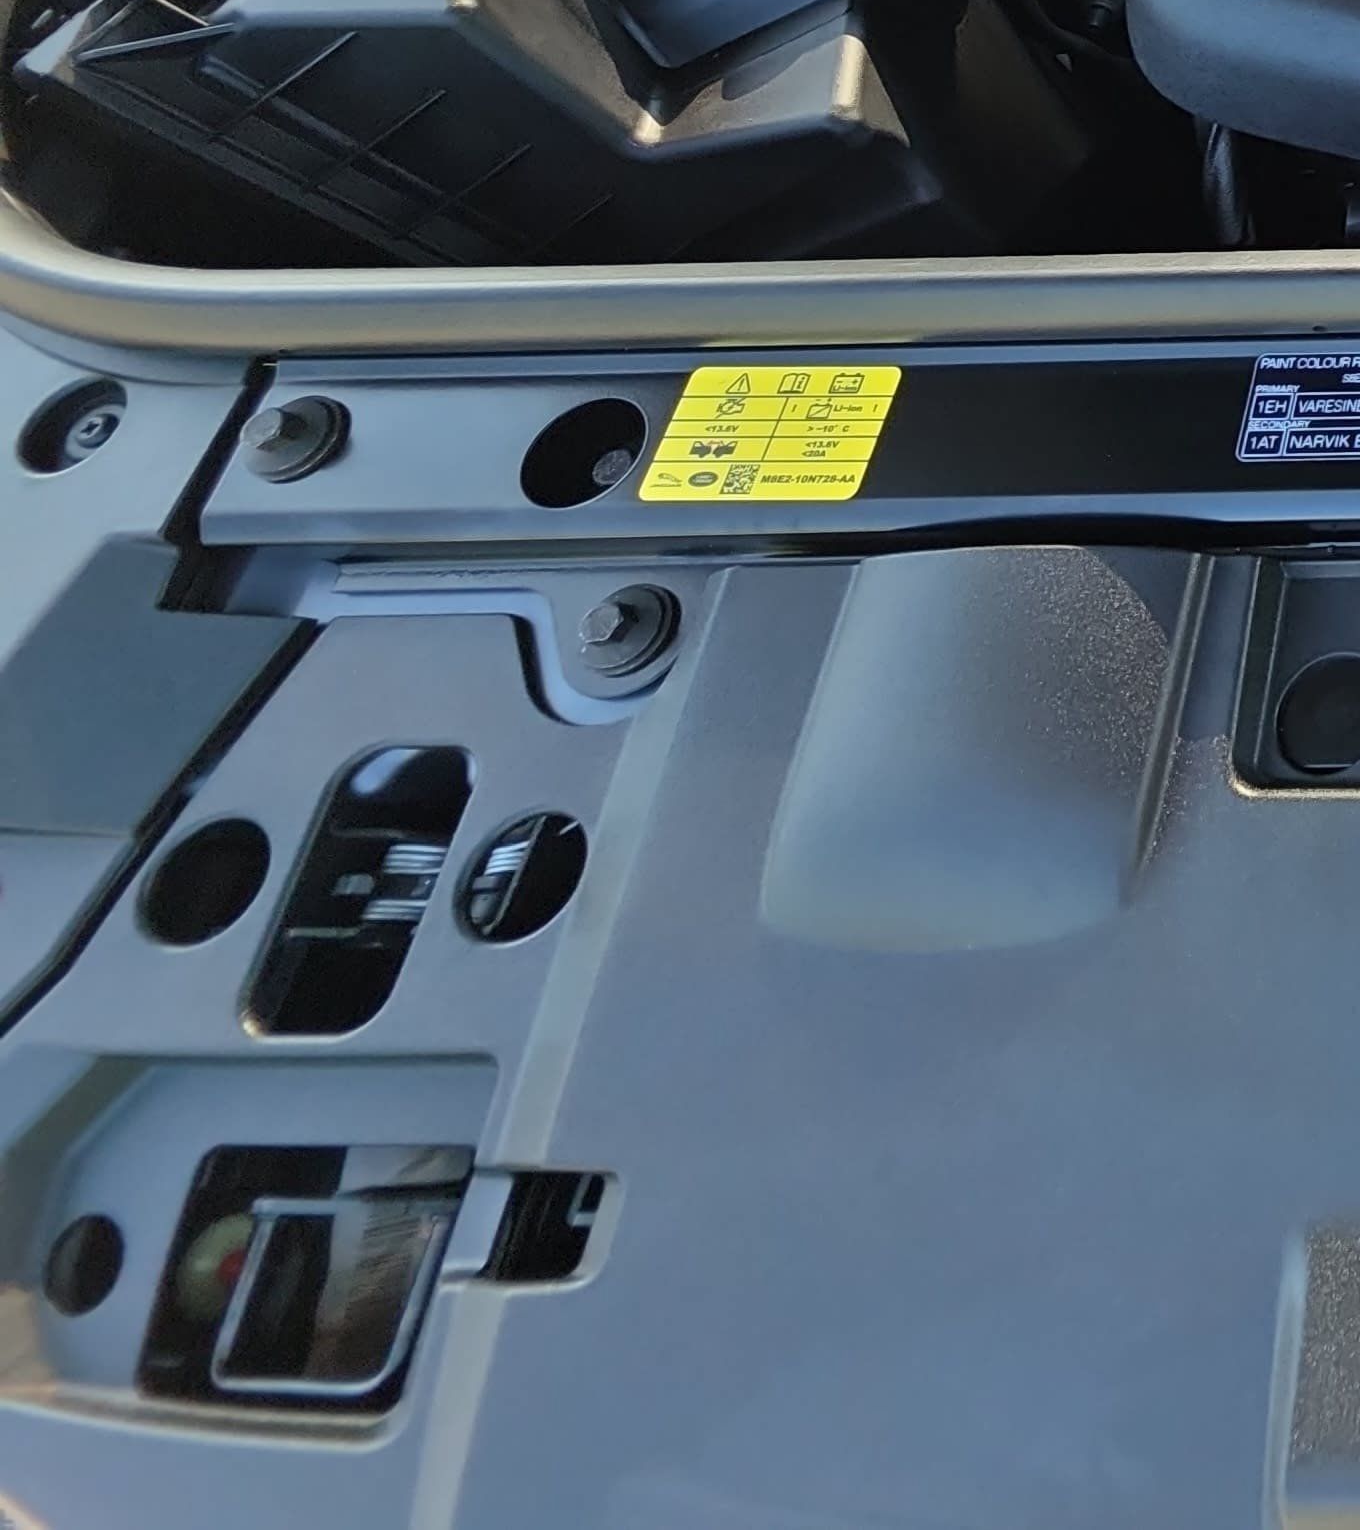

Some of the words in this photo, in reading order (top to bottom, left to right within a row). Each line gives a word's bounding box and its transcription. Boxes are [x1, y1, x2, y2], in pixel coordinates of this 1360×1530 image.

[1260, 356, 1297, 370] PAINT
[1297, 356, 1352, 369] COLOUR
[1255, 384, 1300, 393] PRIMARY
[1257, 399, 1287, 414] 1EH
[1247, 419, 1311, 430] SECONDARY
[1249, 435, 1279, 450] 1AT
[1289, 434, 1351, 449] NARVIK
